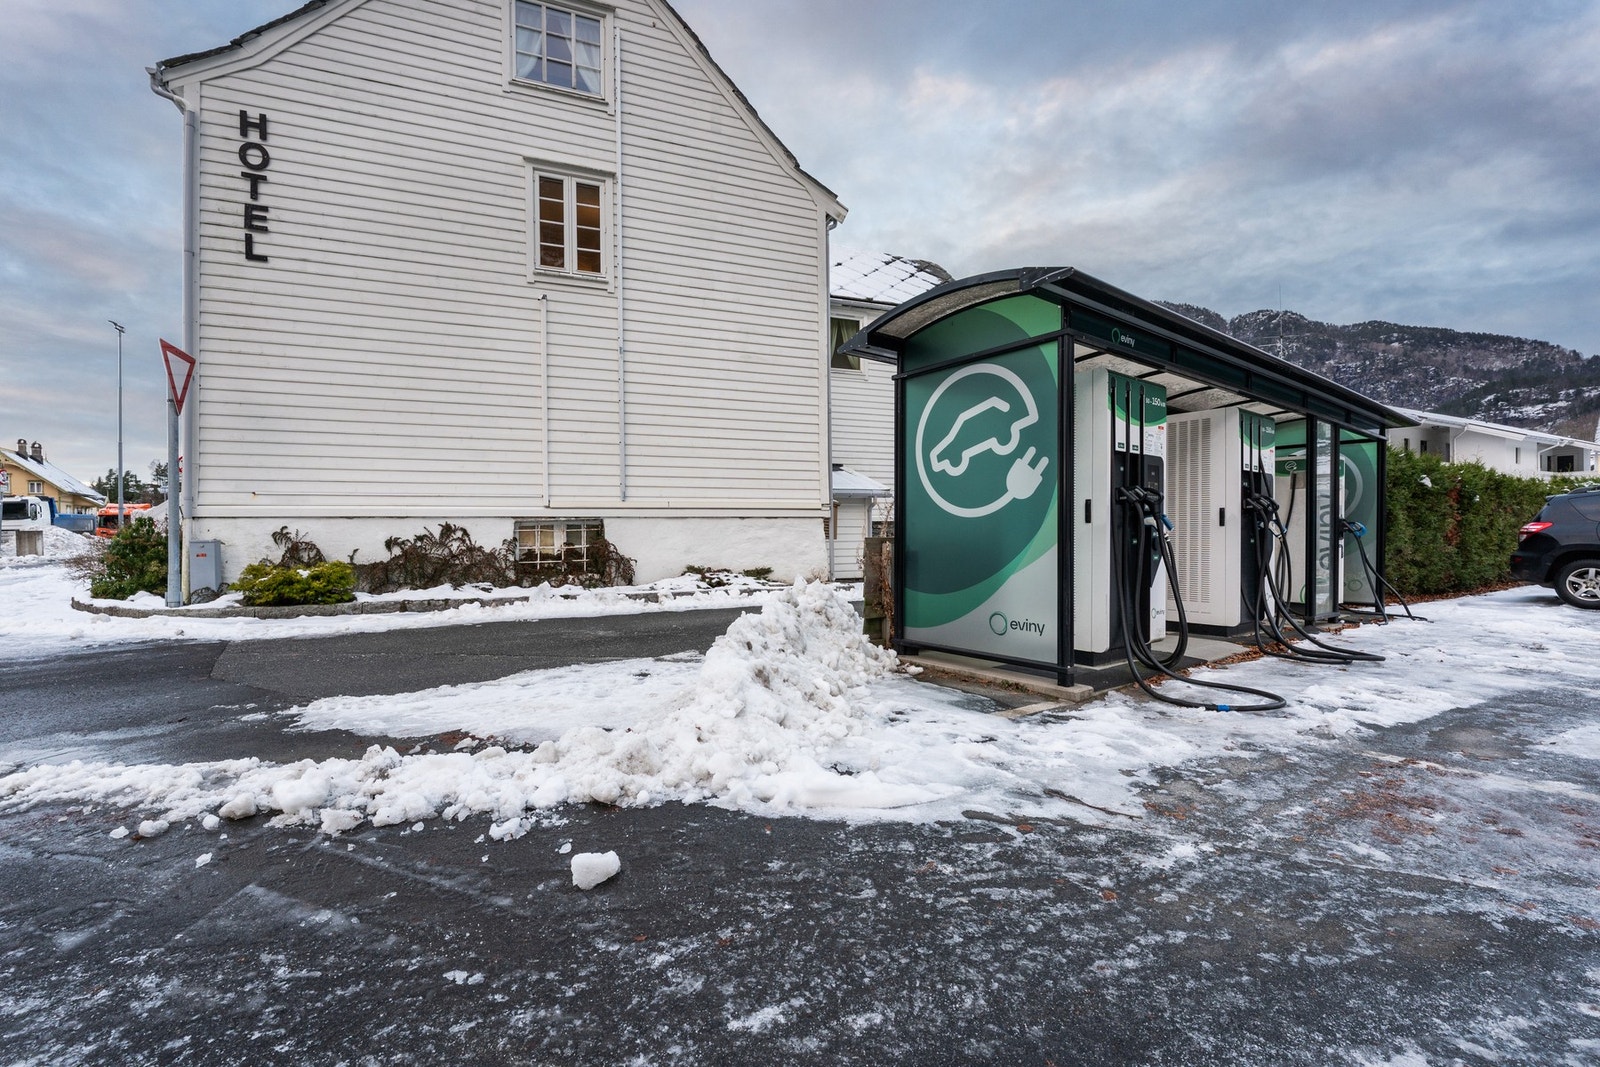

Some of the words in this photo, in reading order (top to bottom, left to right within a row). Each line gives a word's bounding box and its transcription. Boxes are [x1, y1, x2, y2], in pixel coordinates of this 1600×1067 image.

[239, 110, 270, 262] HOTEL
[1120, 335, 1135, 348] eviny
[1010, 618, 1045, 636] eviny
